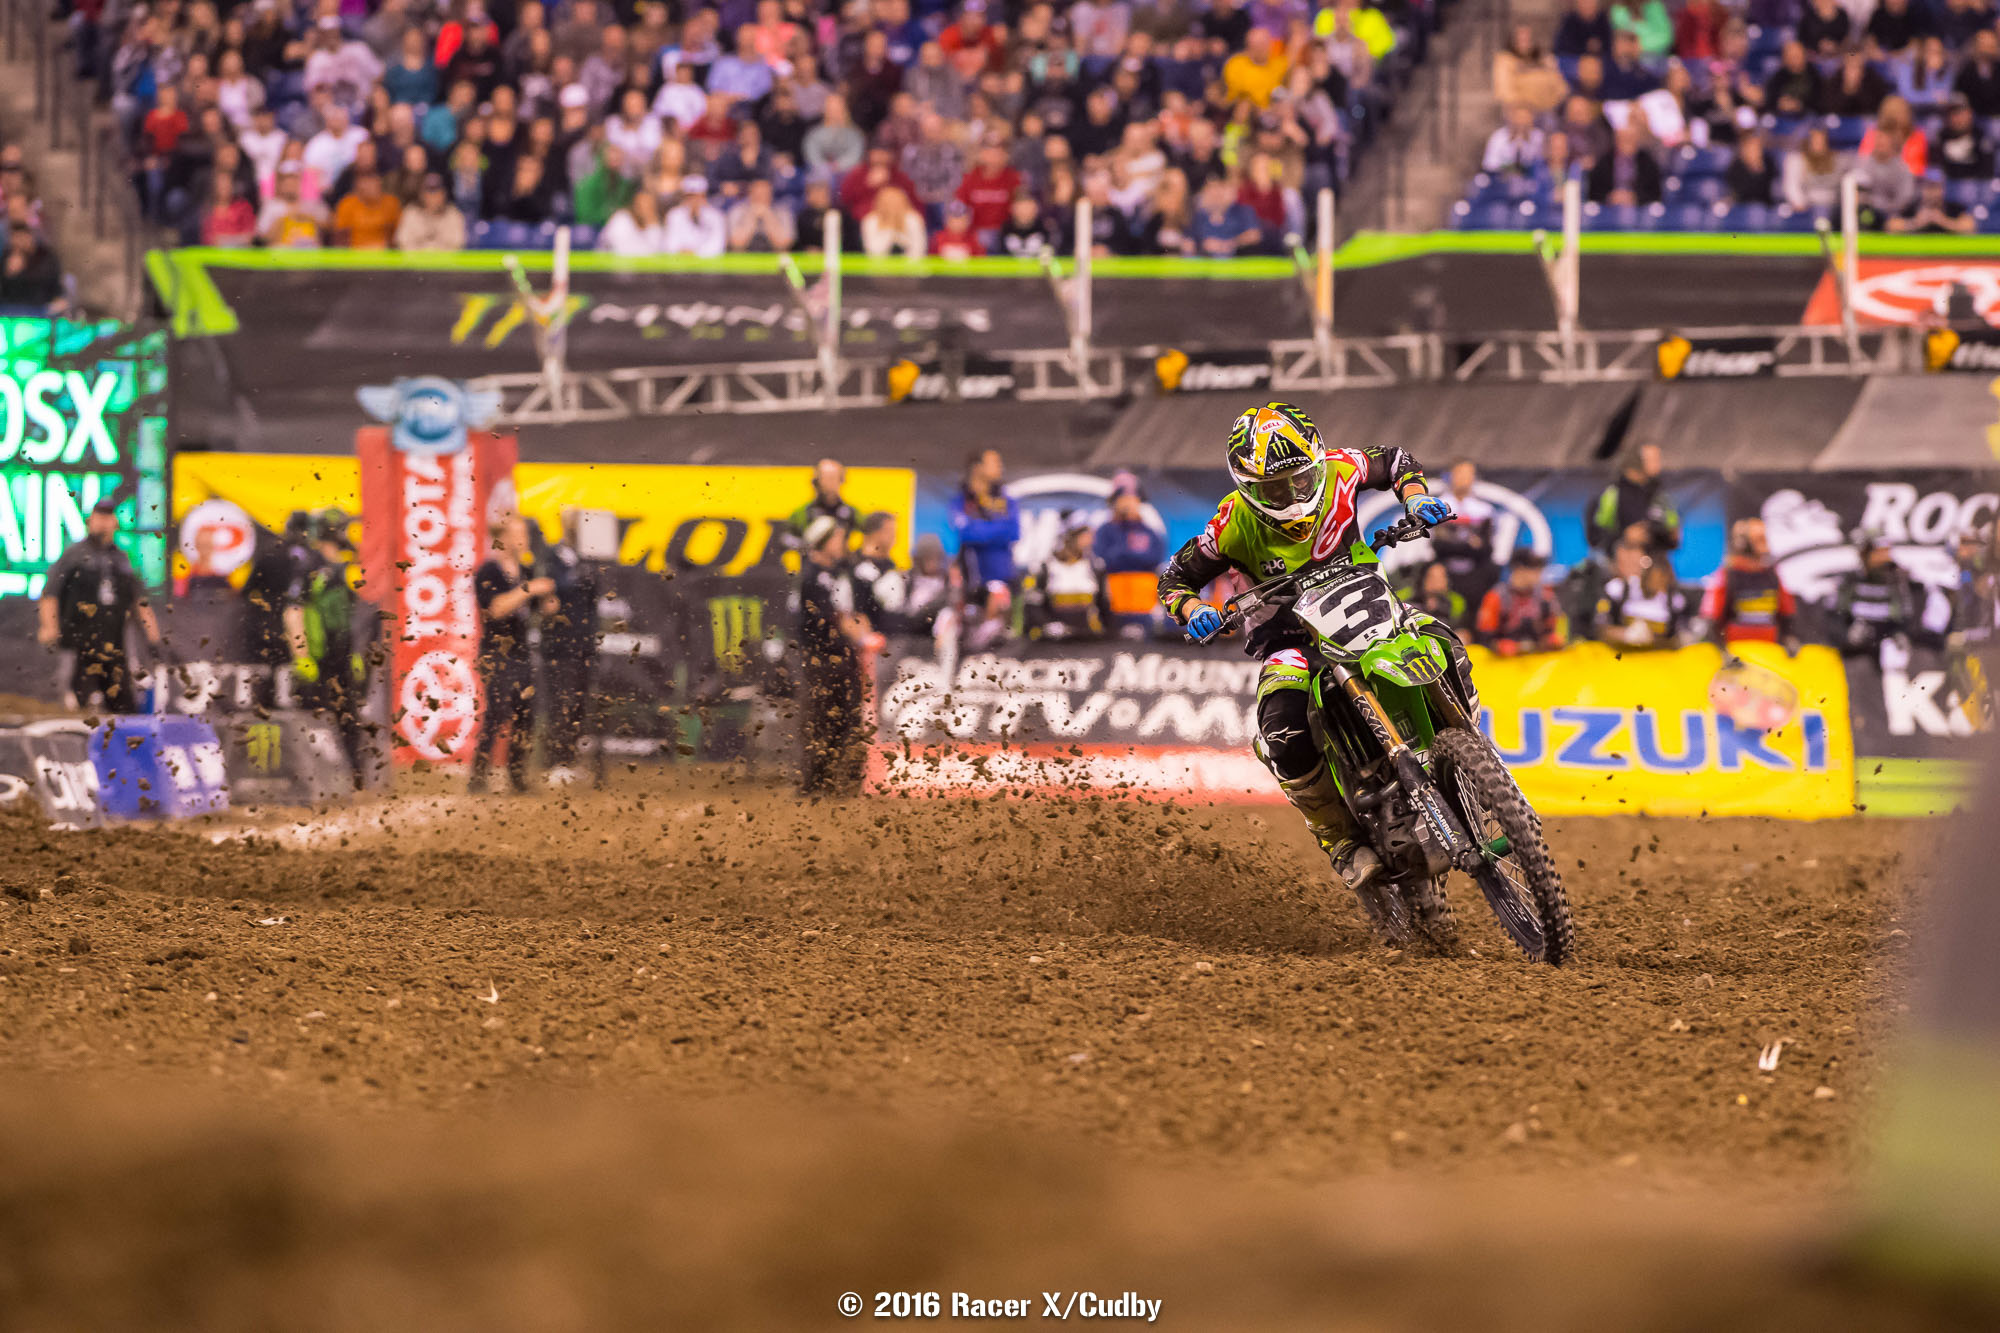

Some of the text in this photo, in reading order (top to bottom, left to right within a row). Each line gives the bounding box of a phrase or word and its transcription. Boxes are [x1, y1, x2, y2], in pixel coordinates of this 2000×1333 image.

[1266, 456, 1311, 472] MONSTER
[1319, 575, 1393, 647] 3
[1410, 789, 1450, 850] DUNLOP
